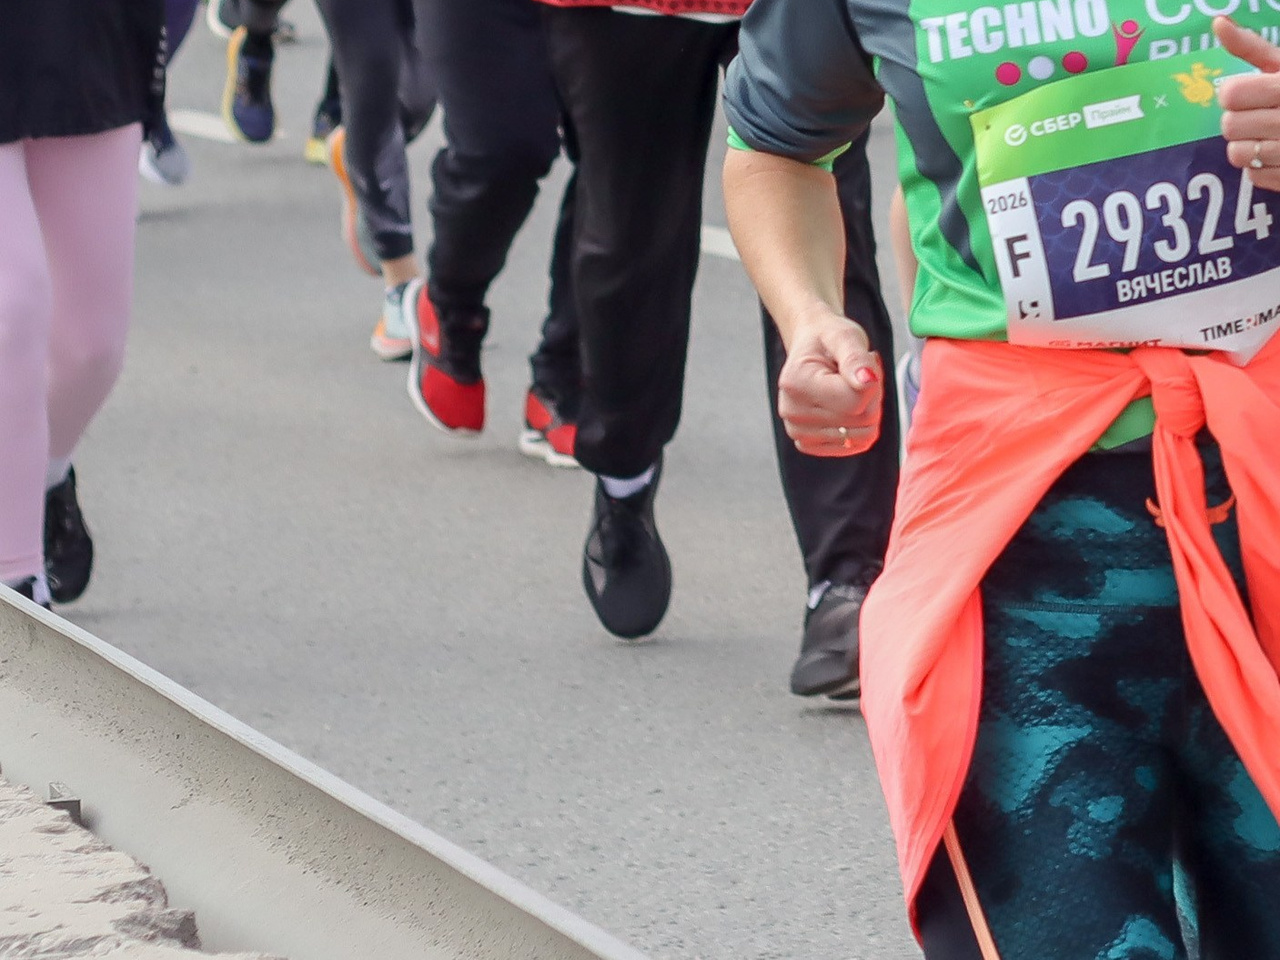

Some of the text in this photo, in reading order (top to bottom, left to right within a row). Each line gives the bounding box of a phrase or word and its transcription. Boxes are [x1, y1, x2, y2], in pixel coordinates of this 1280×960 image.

[1029, 112, 1082, 137] СБЕР
[987, 190, 1029, 215] 2026
[1060, 172, 1274, 283] 29324
[1005, 233, 1032, 278] F
[1115, 256, 1234, 303] ВЯЧЕСЛАВ
